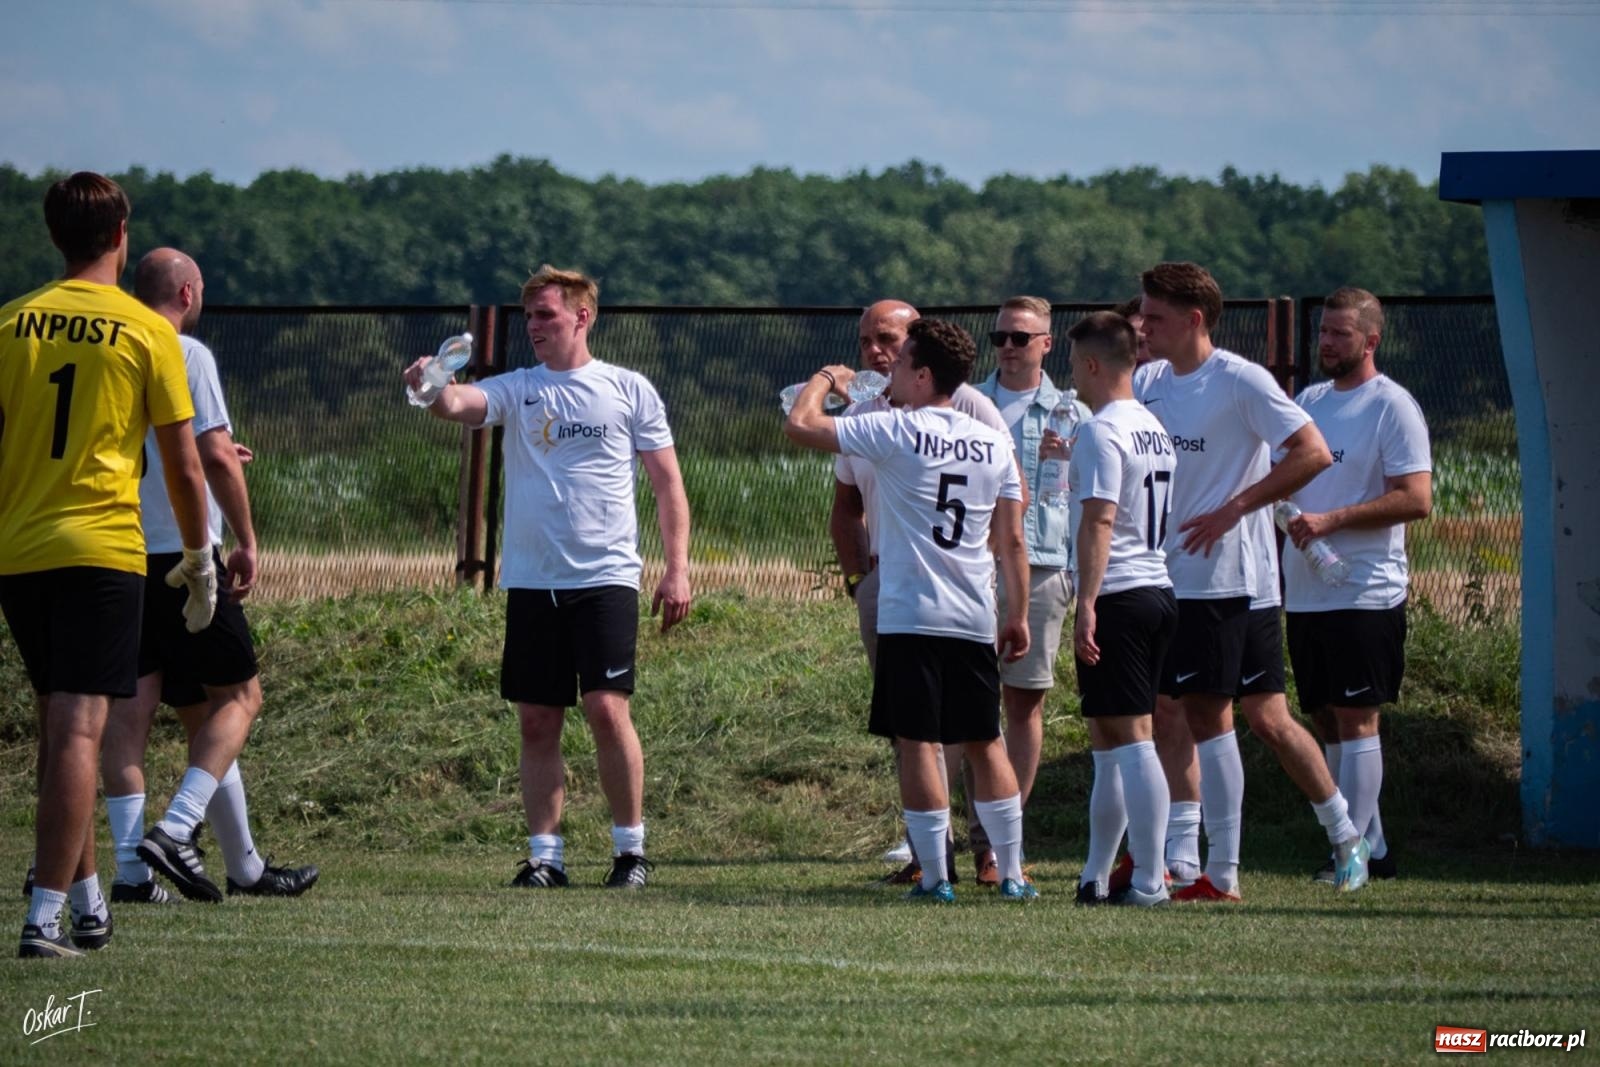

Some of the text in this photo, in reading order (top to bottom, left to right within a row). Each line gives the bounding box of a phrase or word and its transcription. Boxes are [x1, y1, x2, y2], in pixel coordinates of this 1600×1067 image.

[15, 312, 127, 347] INPOST
[48, 362, 77, 460] 1
[557, 423, 609, 440] InPost
[914, 431, 995, 465] INPOST
[1130, 430, 1174, 457] INPOS
[1170, 434, 1207, 453] Post
[932, 472, 968, 550] 5
[1143, 470, 1171, 551] 17
